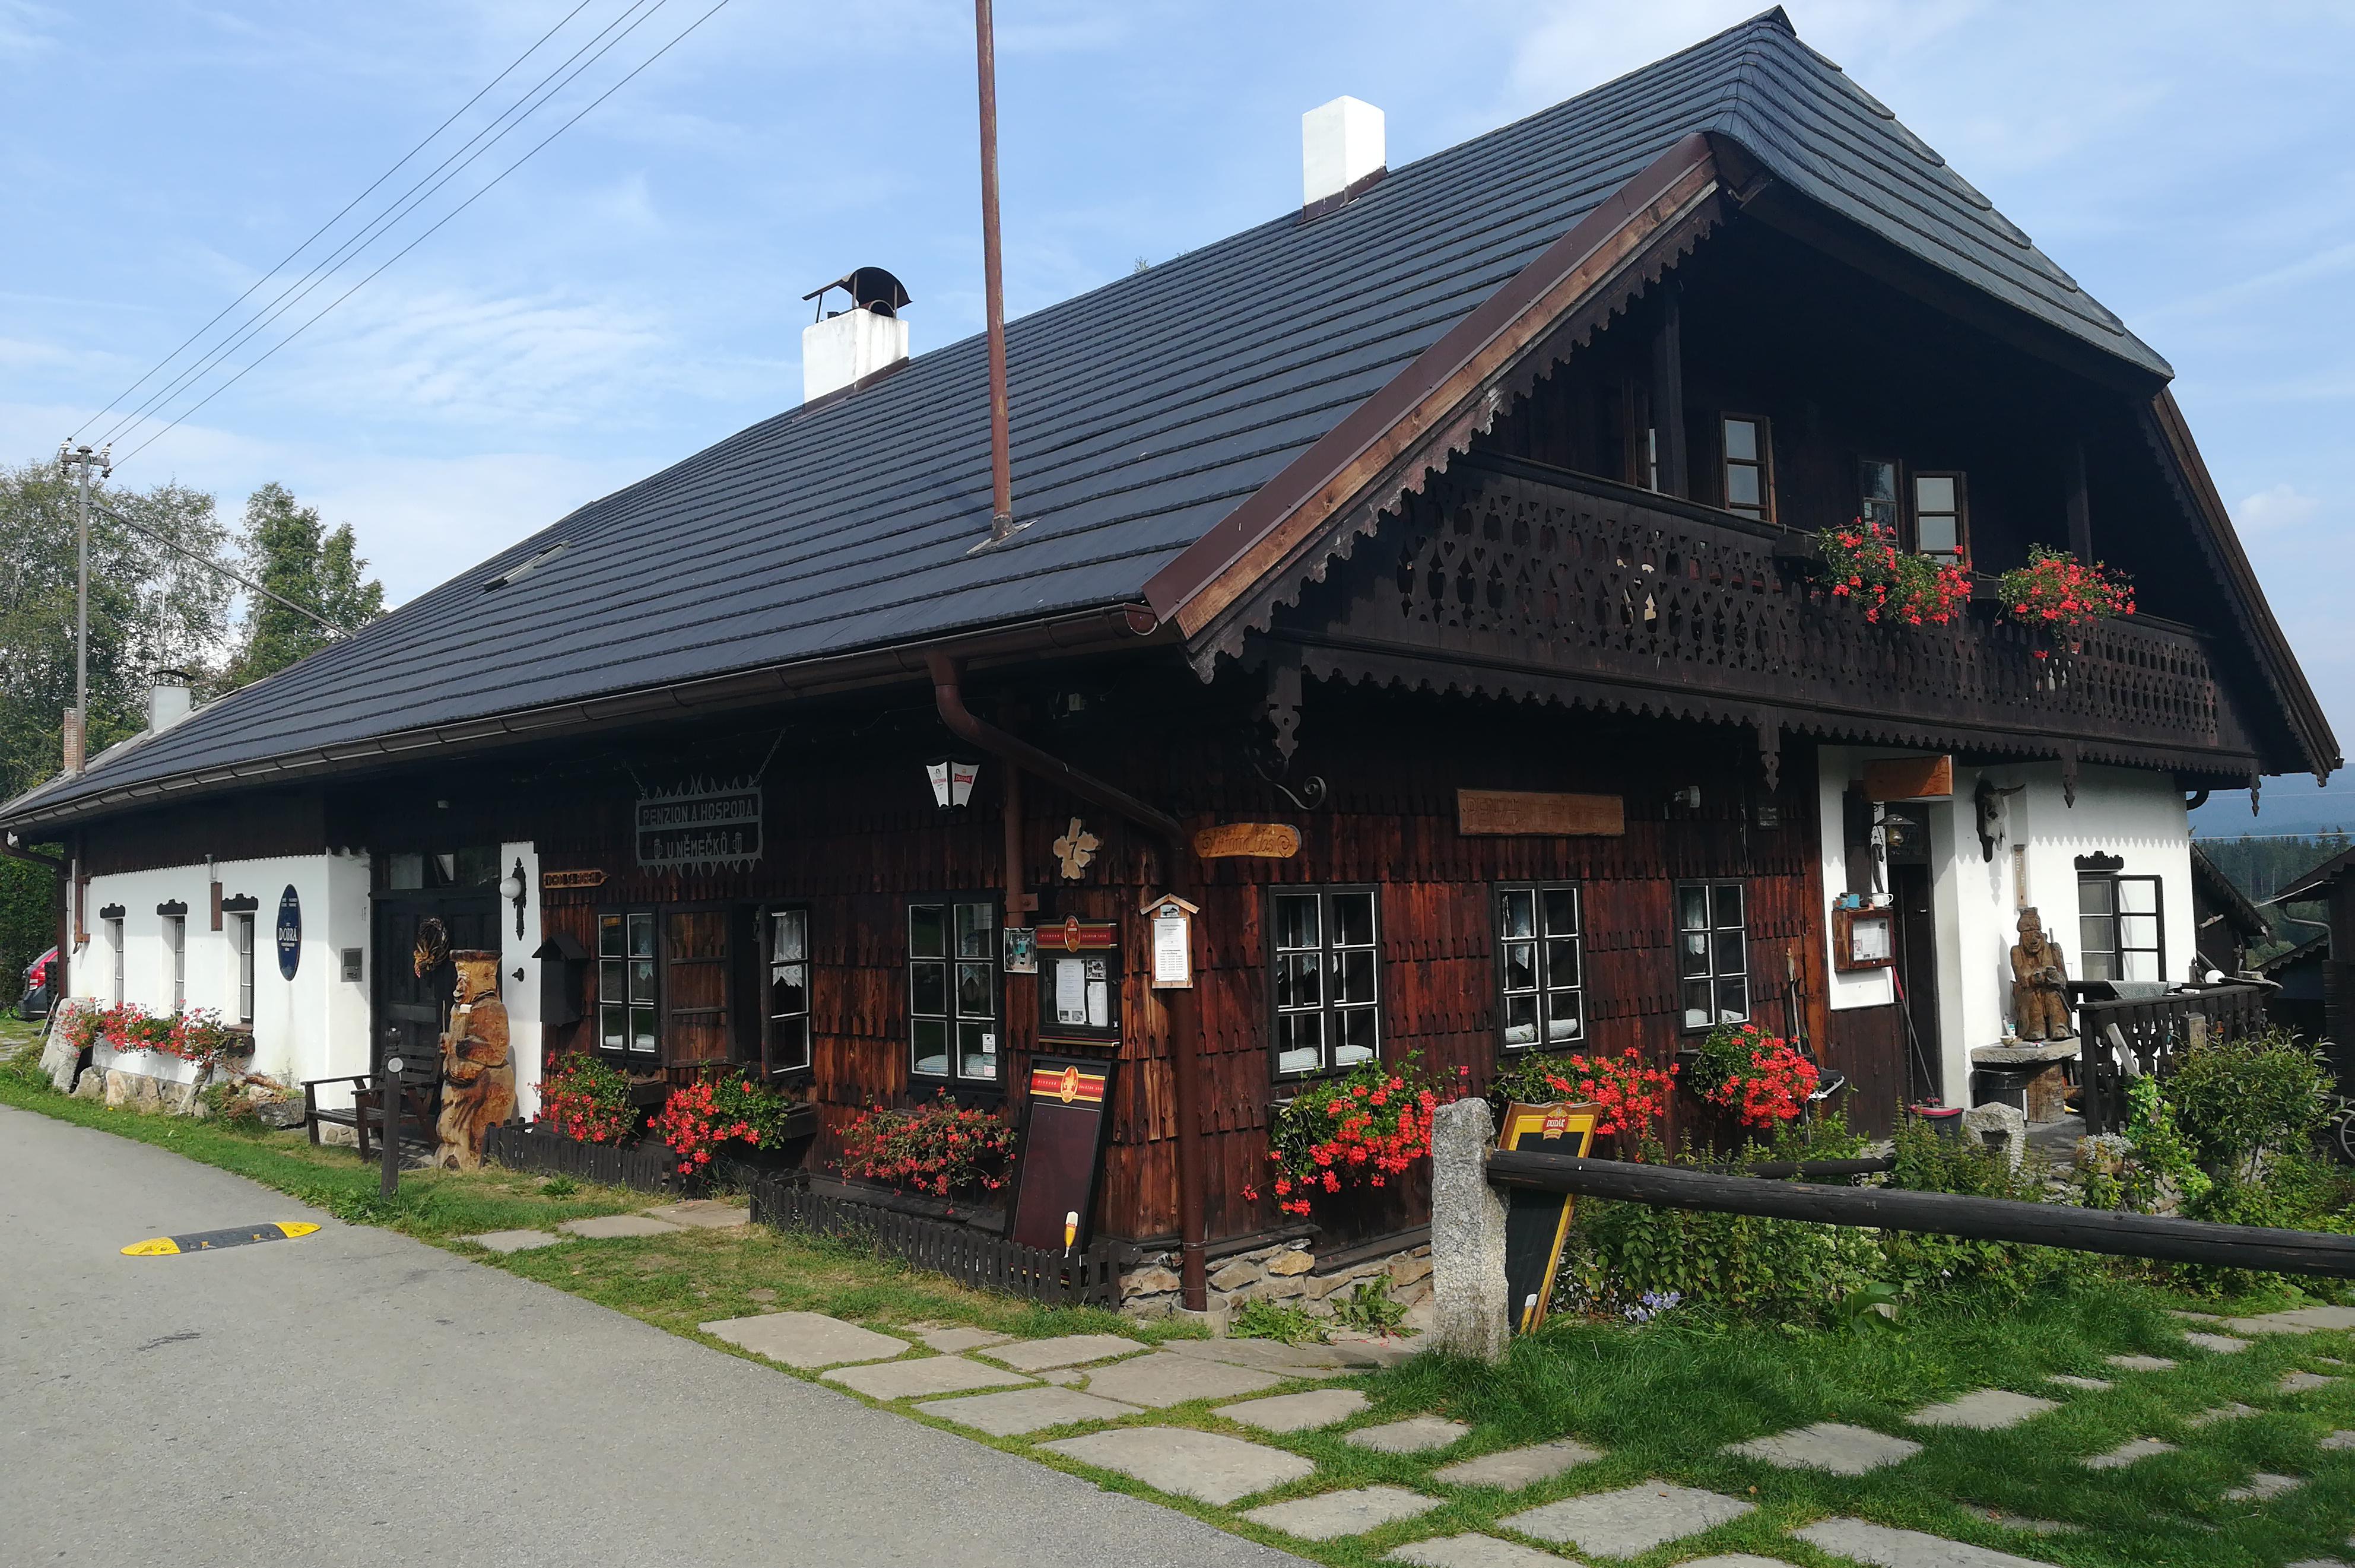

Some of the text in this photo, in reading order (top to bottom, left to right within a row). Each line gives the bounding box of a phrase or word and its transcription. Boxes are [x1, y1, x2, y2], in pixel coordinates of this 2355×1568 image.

[643, 799, 753, 826] PENZION A HOSPODA
[667, 831, 727, 858] U NĚMEČKŮ
[1069, 841, 1078, 860] 7
[279, 926, 297, 941] DOBRÁ
